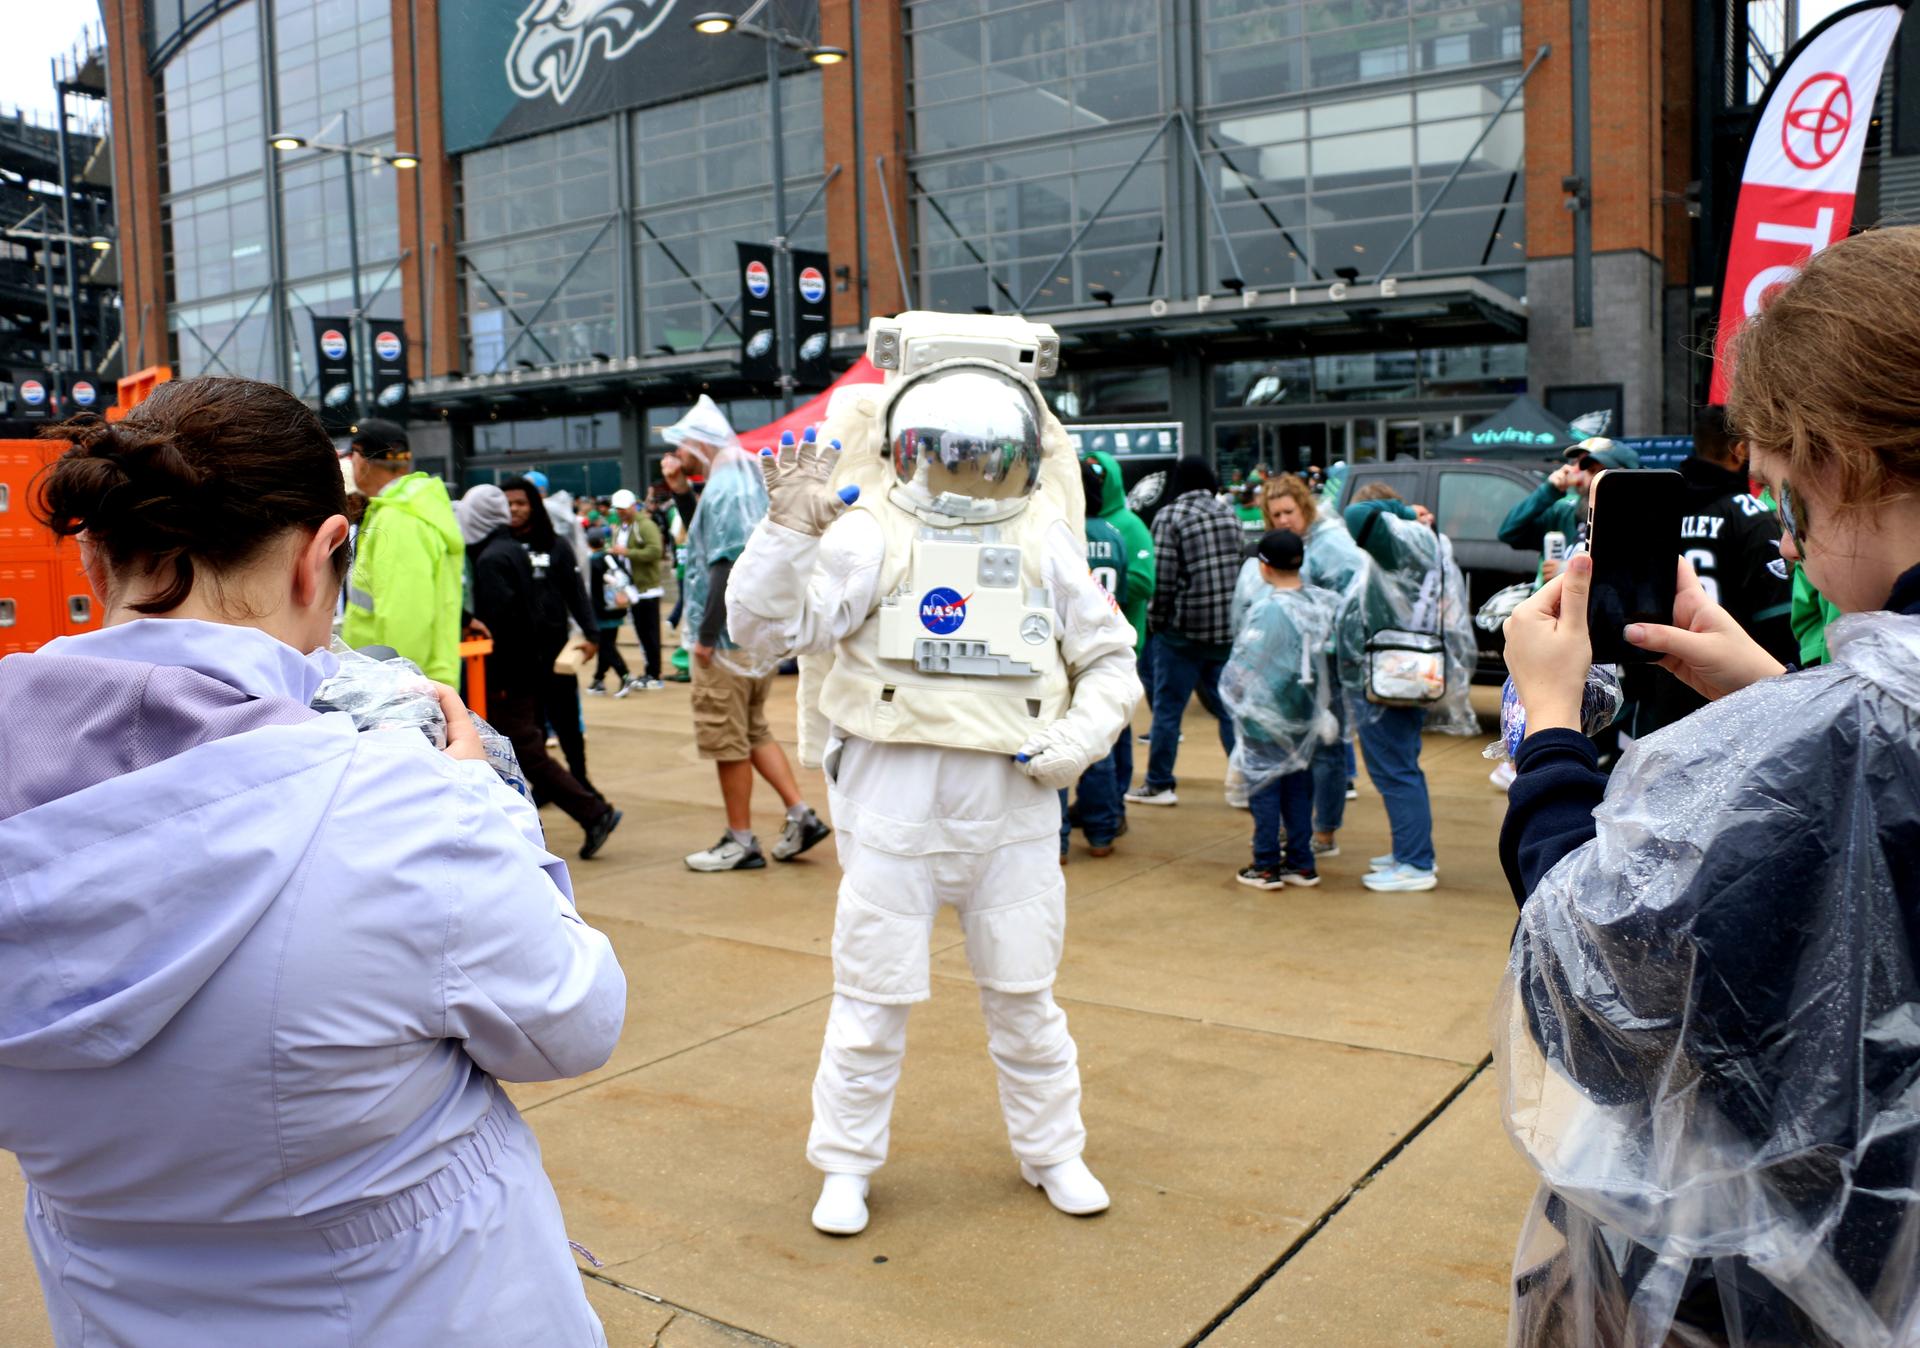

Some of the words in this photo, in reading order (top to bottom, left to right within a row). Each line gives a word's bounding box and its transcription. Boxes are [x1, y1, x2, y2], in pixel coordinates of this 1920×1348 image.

[1150, 278, 1397, 318] OFFICE
[541, 356, 638, 379] SUITES
[1472, 426, 1535, 445] vivint
[922, 604, 964, 618] NASA
